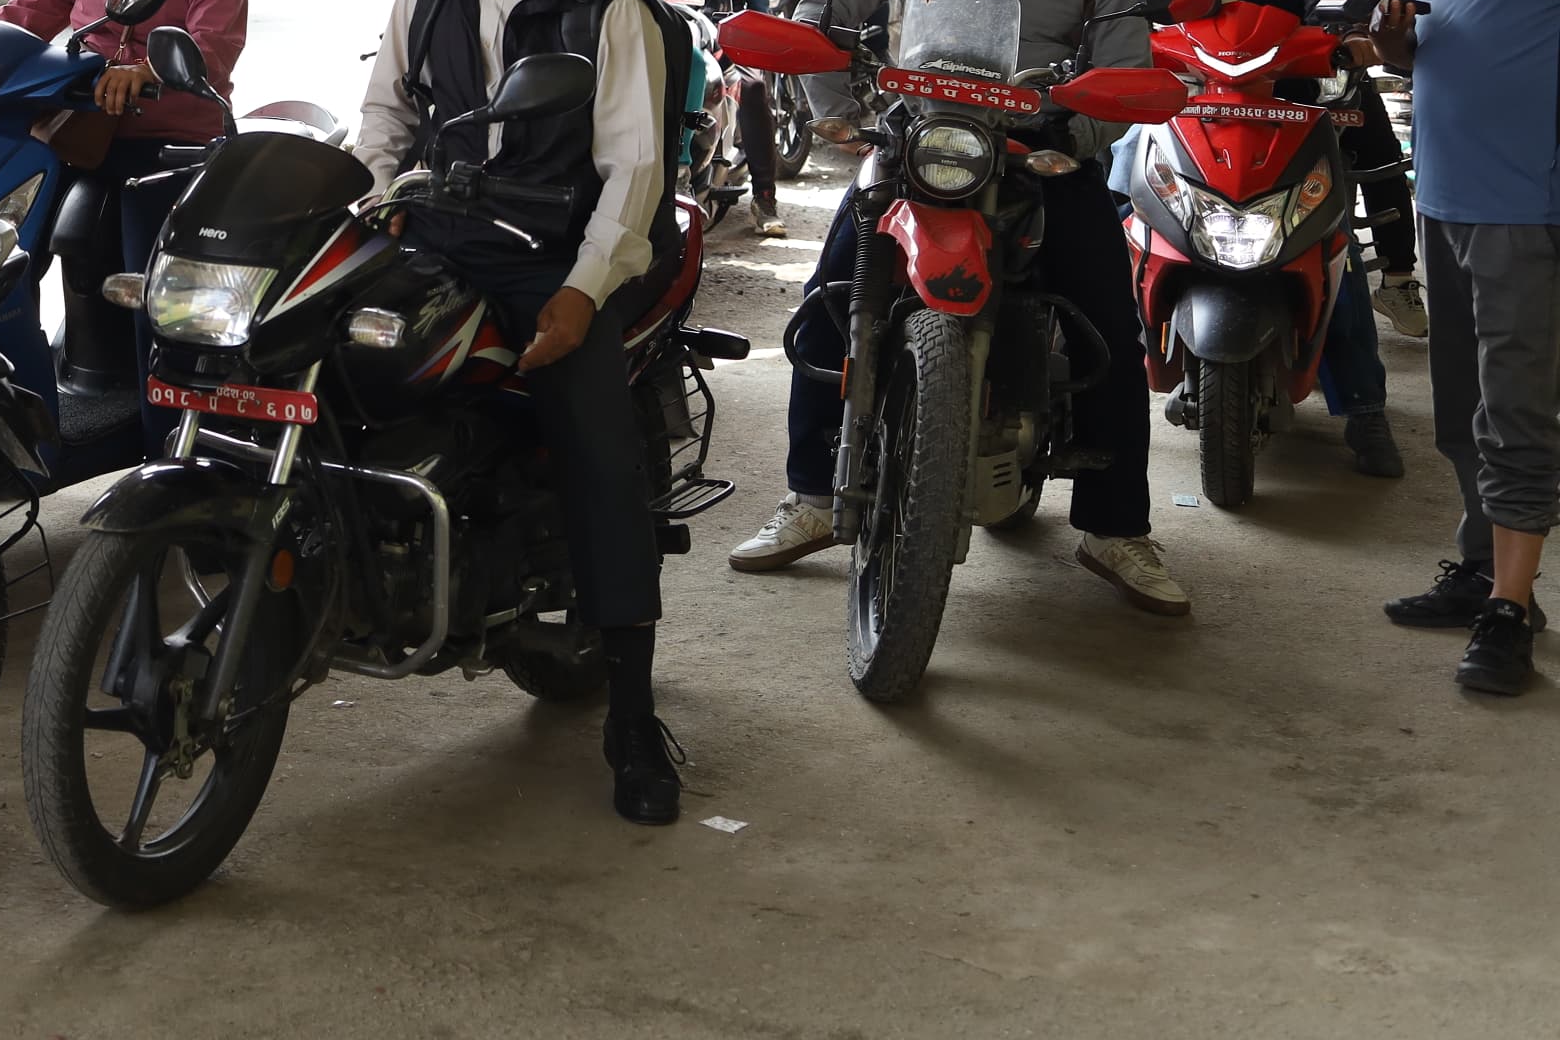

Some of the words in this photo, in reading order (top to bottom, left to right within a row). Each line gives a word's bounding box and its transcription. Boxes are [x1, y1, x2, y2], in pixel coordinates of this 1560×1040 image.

[943, 61, 1002, 80] alpinestars
[886, 81, 933, 94] ०३७
[943, 89, 959, 98] प
[970, 93, 1033, 111] ११४७
[199, 227, 227, 240] Hero
